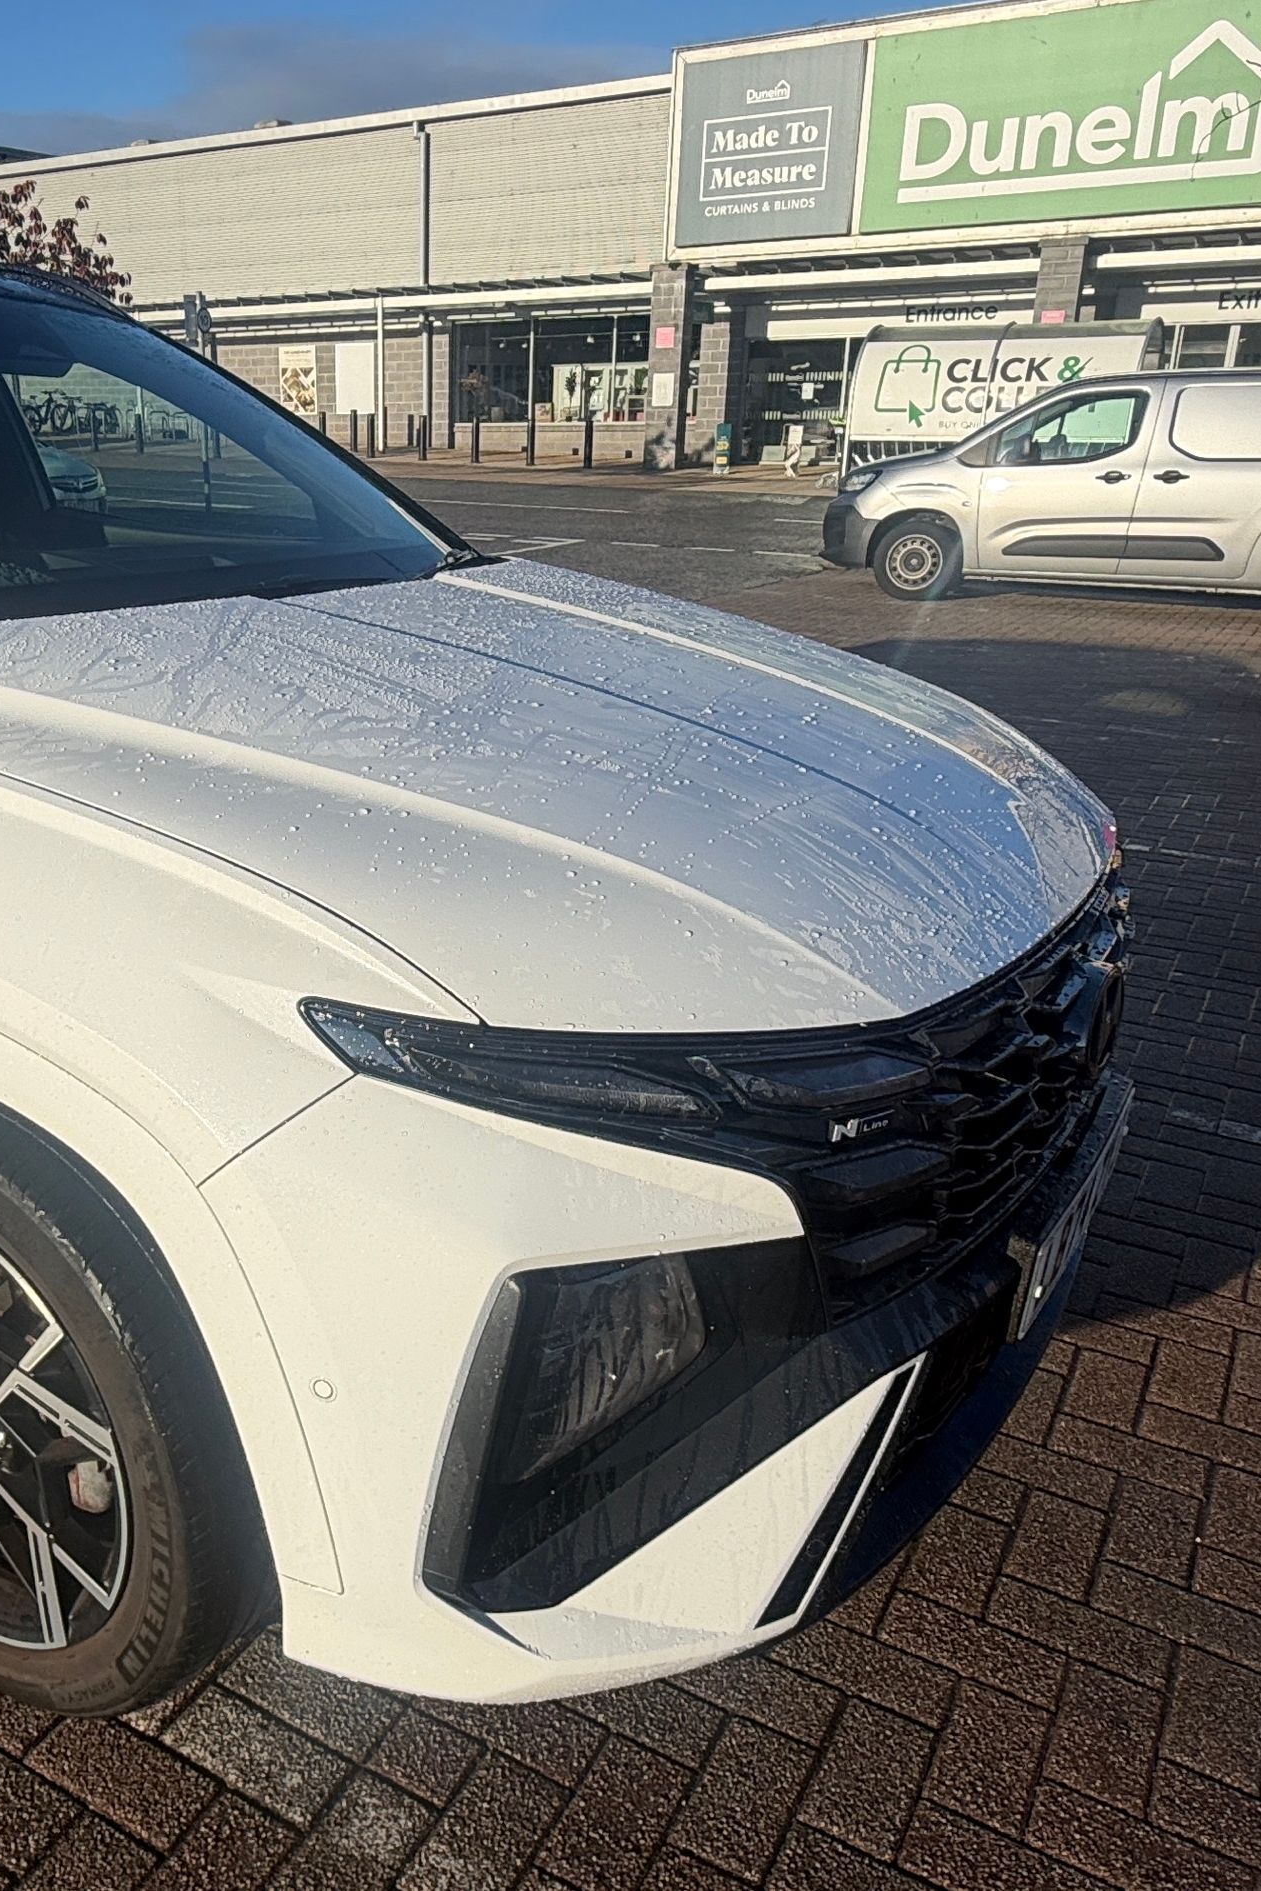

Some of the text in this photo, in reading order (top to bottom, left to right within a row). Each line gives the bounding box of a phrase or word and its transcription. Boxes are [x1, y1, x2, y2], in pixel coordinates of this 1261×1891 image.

[746, 84, 788, 101] Dunelm
[710, 121, 819, 153] Made To
[899, 70, 1251, 181] Dunelm
[708, 163, 817, 190] Measure
[704, 198, 816, 217] CURTAINS & BLINDS
[905, 305, 998, 323] Entrance
[947, 356, 1084, 383] CLICK &
[832, 1118, 888, 1142] N Line
[122, 1502, 171, 1680] MICHELIN
